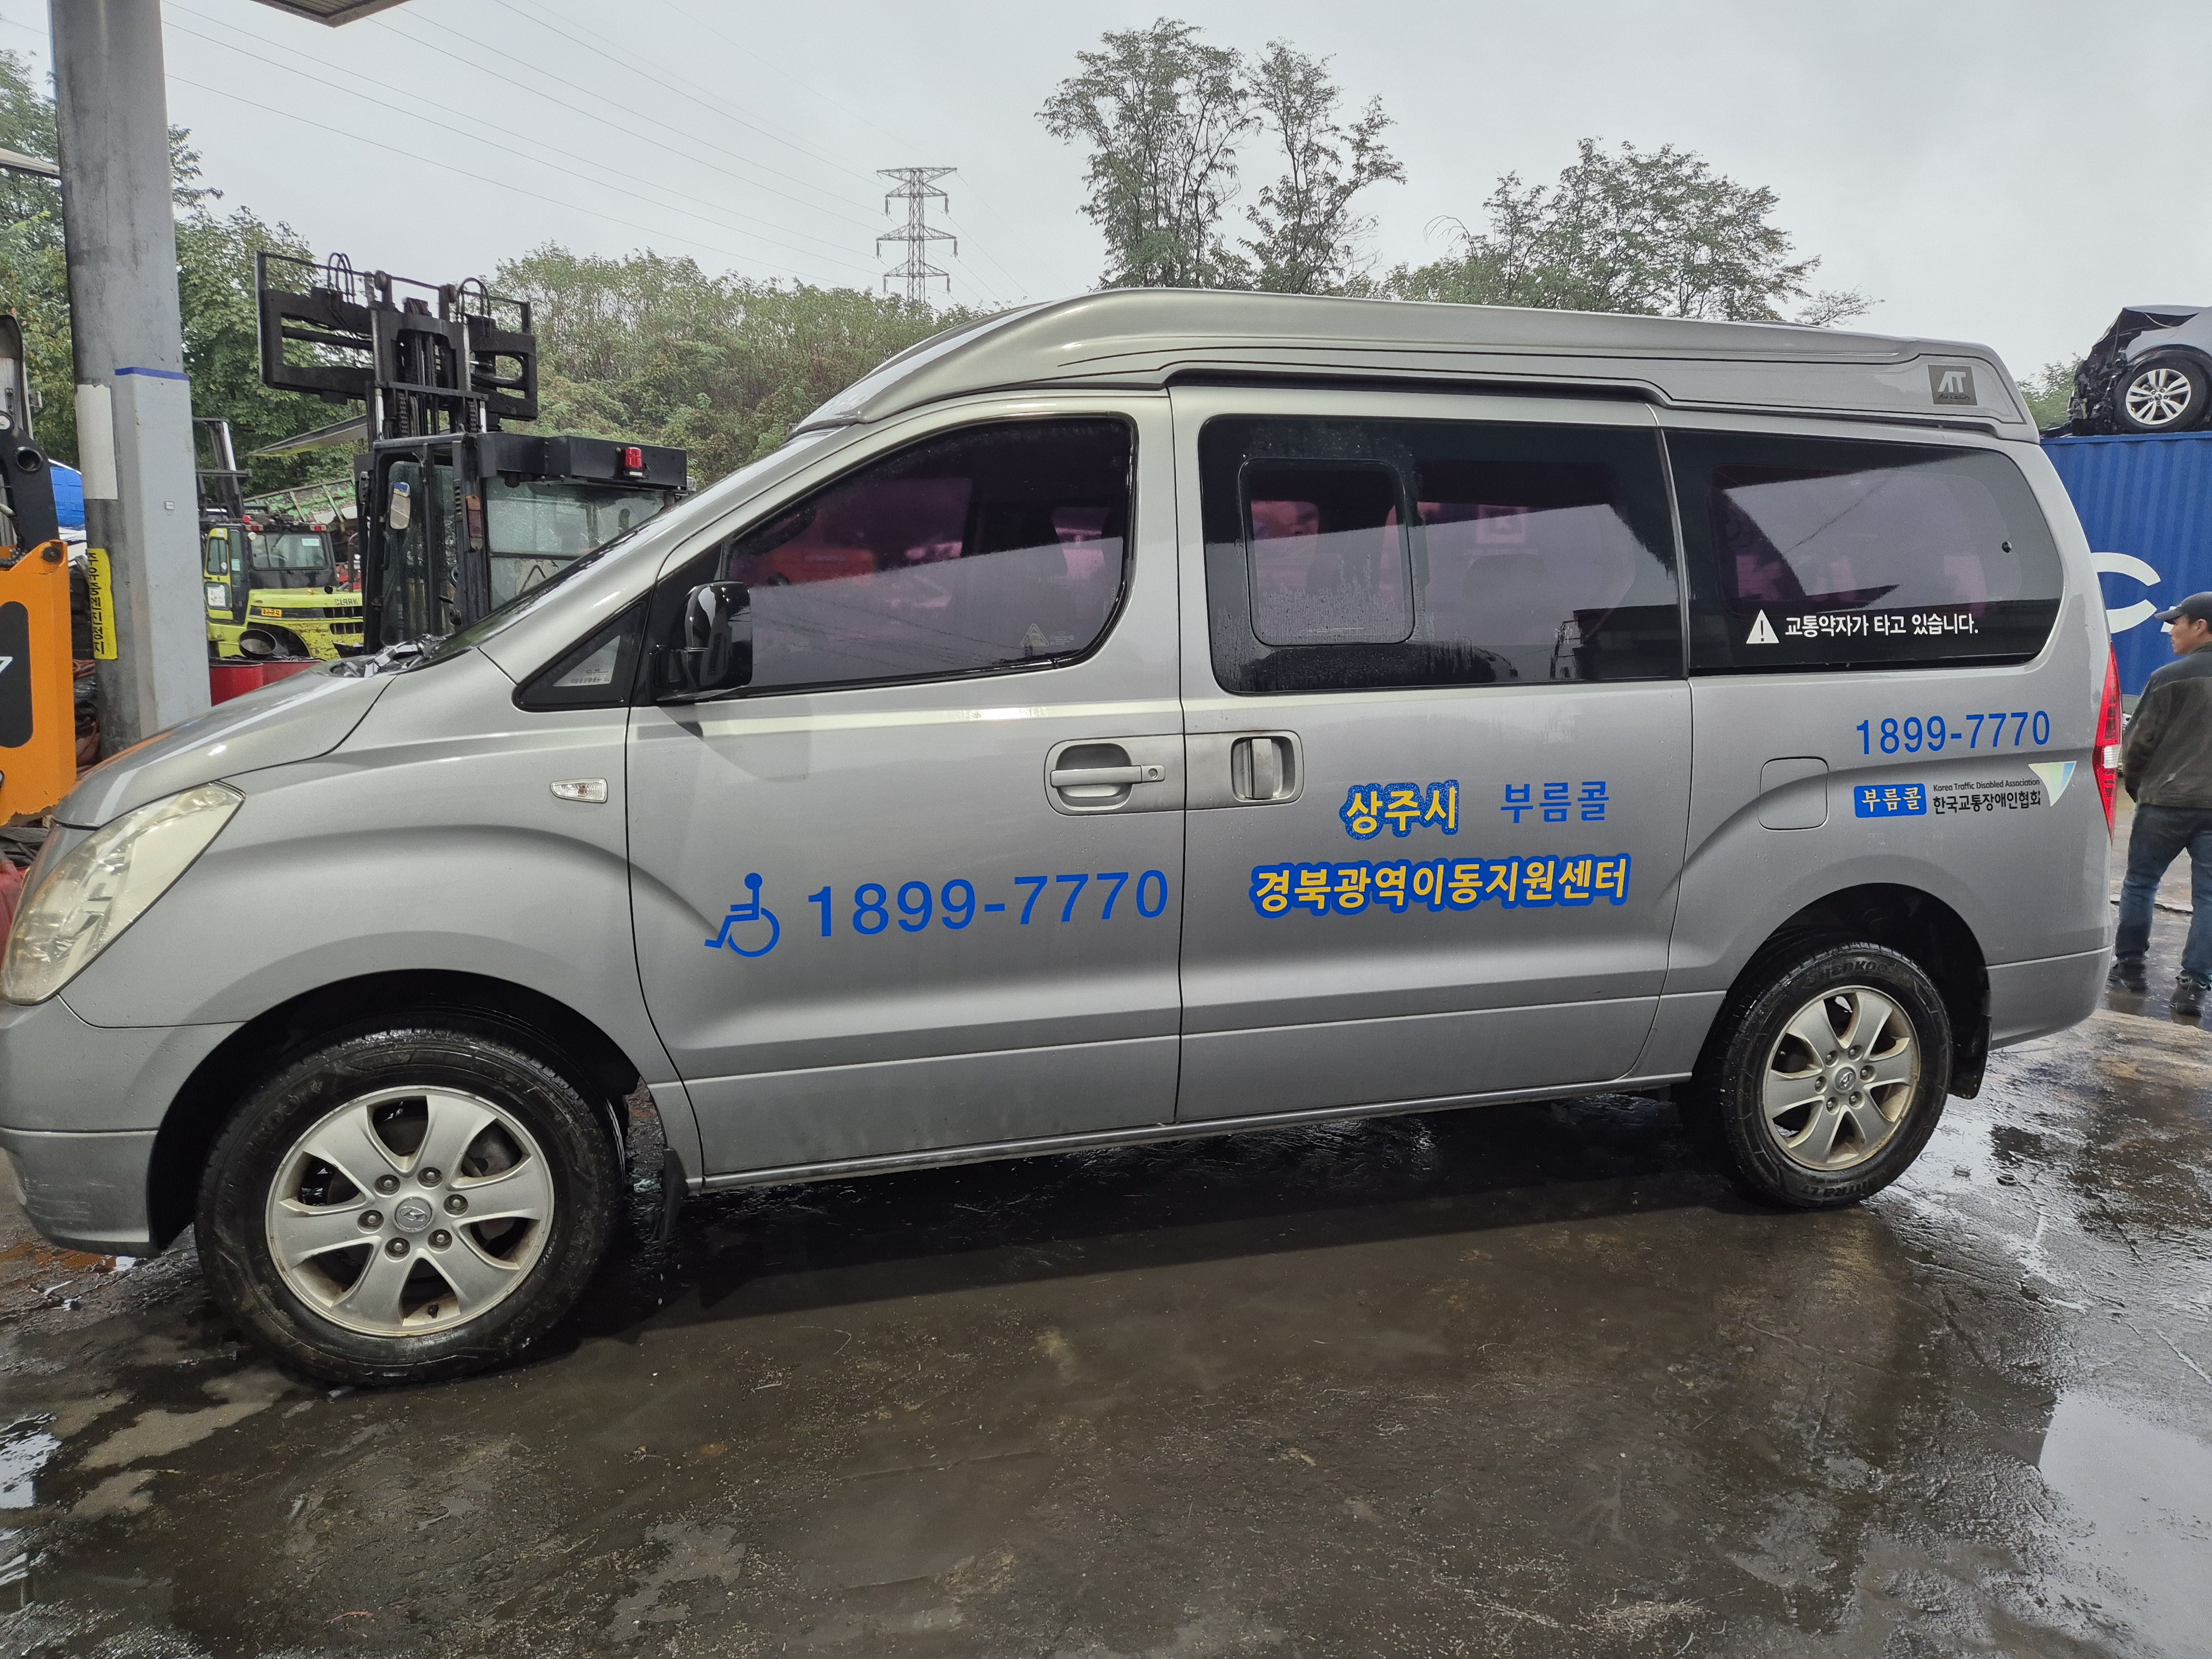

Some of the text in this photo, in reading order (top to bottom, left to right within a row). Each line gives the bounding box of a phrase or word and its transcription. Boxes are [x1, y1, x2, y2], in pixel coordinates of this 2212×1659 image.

[1785, 613, 1979, 637] 교통약자가 타고 있습니다.
[1856, 711, 2050, 755] 1899-7770
[1861, 787, 1922, 812] 부름콜
[1954, 782, 1975, 791] Traffic
[1976, 780, 2004, 789] Disabled
[2005, 778, 2040, 787] Association
[1341, 781, 1610, 839] 상주시 부름콜
[1933, 790, 2041, 815] 한국교통장애인협회
[808, 869, 1168, 937] 1899-7770
[1251, 855, 1630, 917] 경북광역이동지원센터
